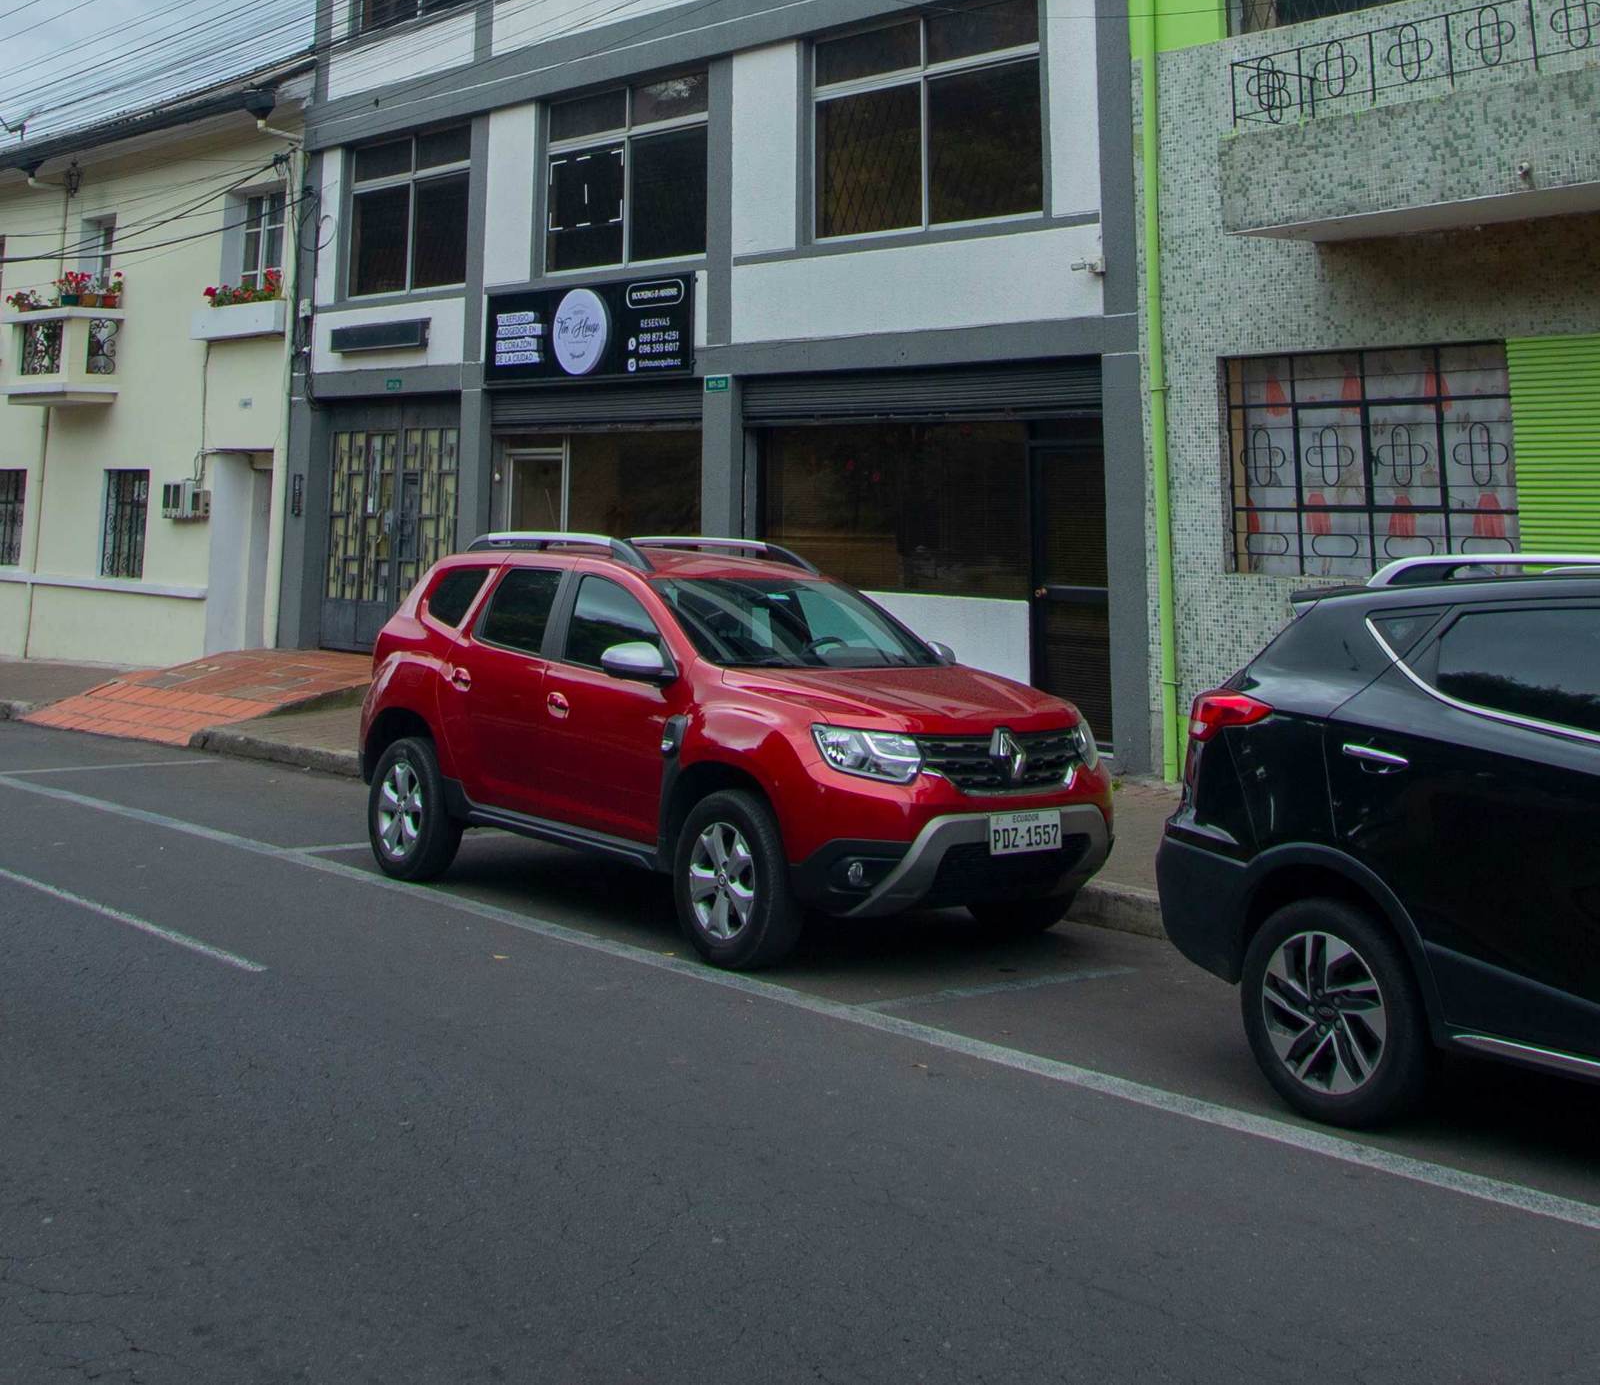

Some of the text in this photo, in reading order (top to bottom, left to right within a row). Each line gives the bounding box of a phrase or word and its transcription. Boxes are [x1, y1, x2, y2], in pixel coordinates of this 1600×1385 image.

[640, 317, 670, 328] RESERVAS
[498, 325, 537, 336] ACOGEDOR EN
[1012, 813, 1039, 824] ECUADOR
